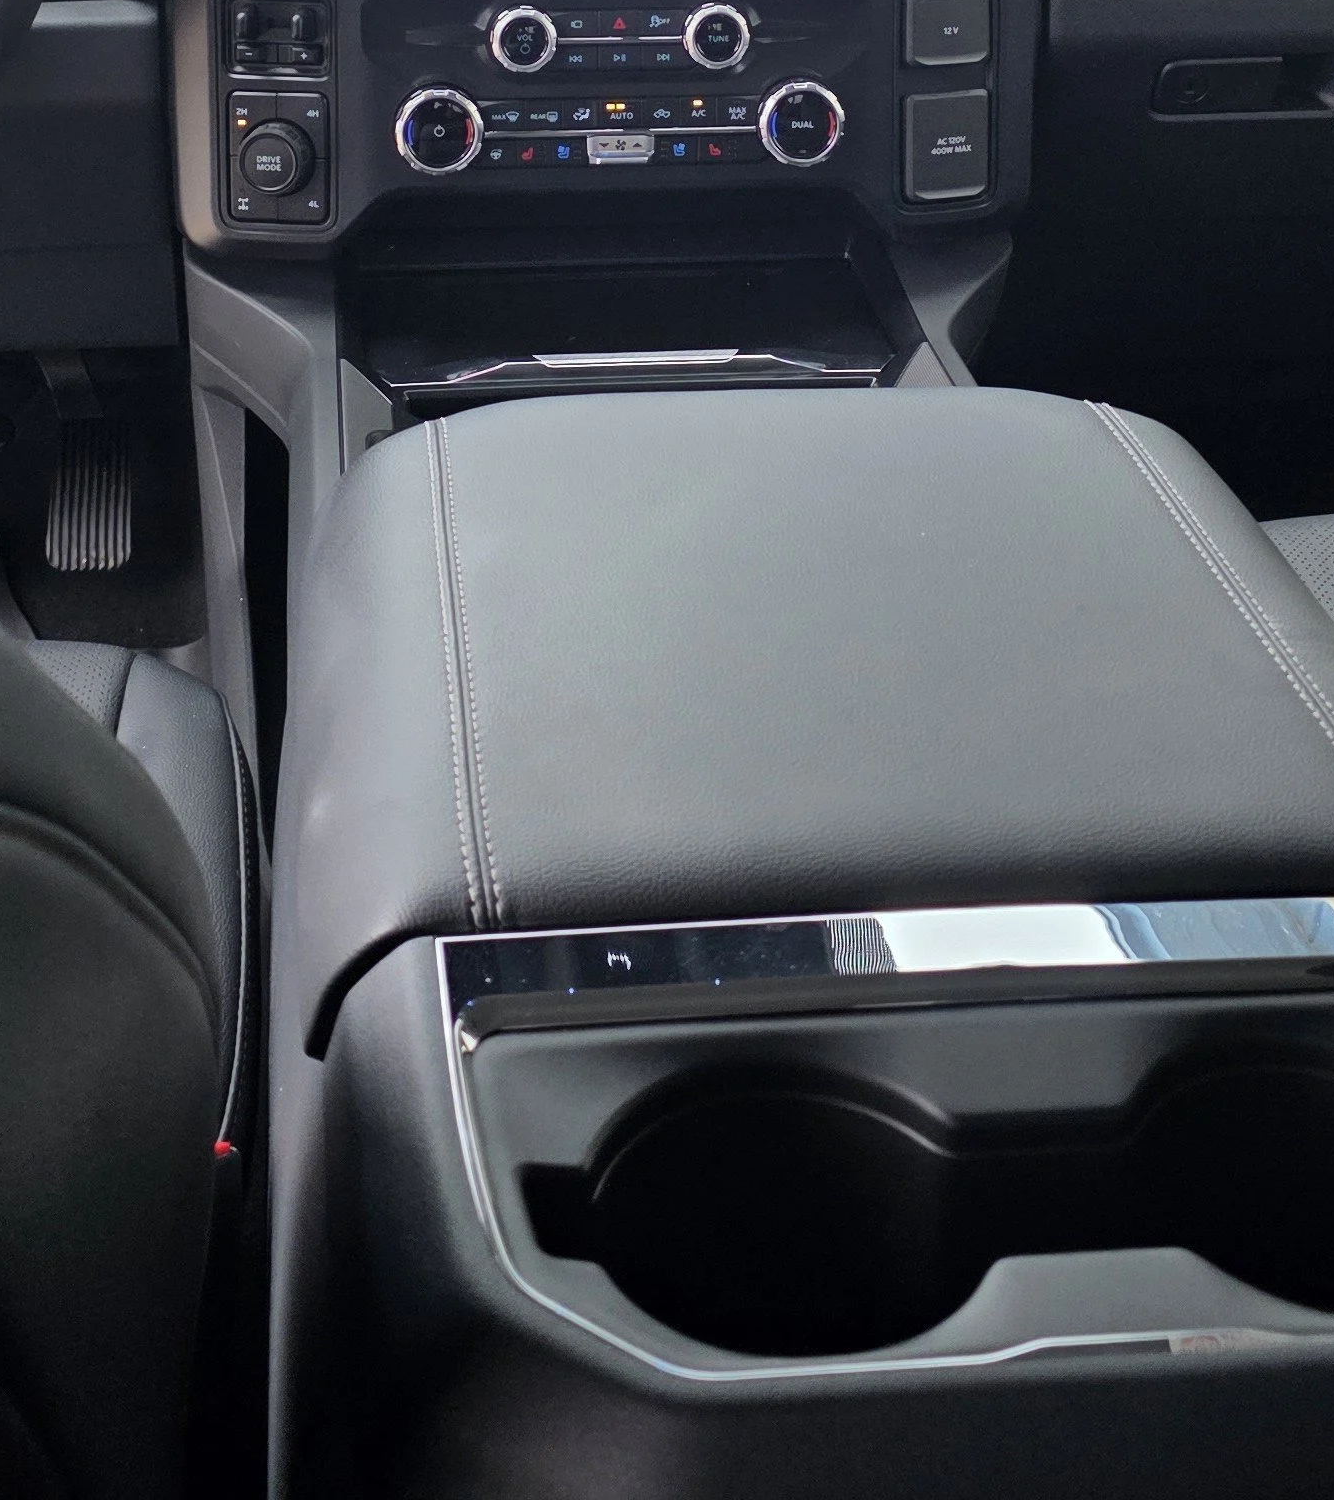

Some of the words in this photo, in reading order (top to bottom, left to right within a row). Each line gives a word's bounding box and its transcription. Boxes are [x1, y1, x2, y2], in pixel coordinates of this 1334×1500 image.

[517, 34, 533, 42] VOL
[708, 35, 730, 43] TUNE
[236, 108, 247, 116] 2H
[307, 110, 319, 118] 4H
[610, 112, 633, 120] AUTO
[692, 109, 706, 118] A/C
[791, 120, 814, 129] DUAL
[937, 137, 947, 146] AC
[948, 135, 966, 144] 120V
[931, 146, 954, 155] 400W
[955, 144, 972, 153] MAX
[256, 155, 281, 164] DRIVE
[256, 163, 282, 172] MODE
[308, 200, 319, 208] 4L
